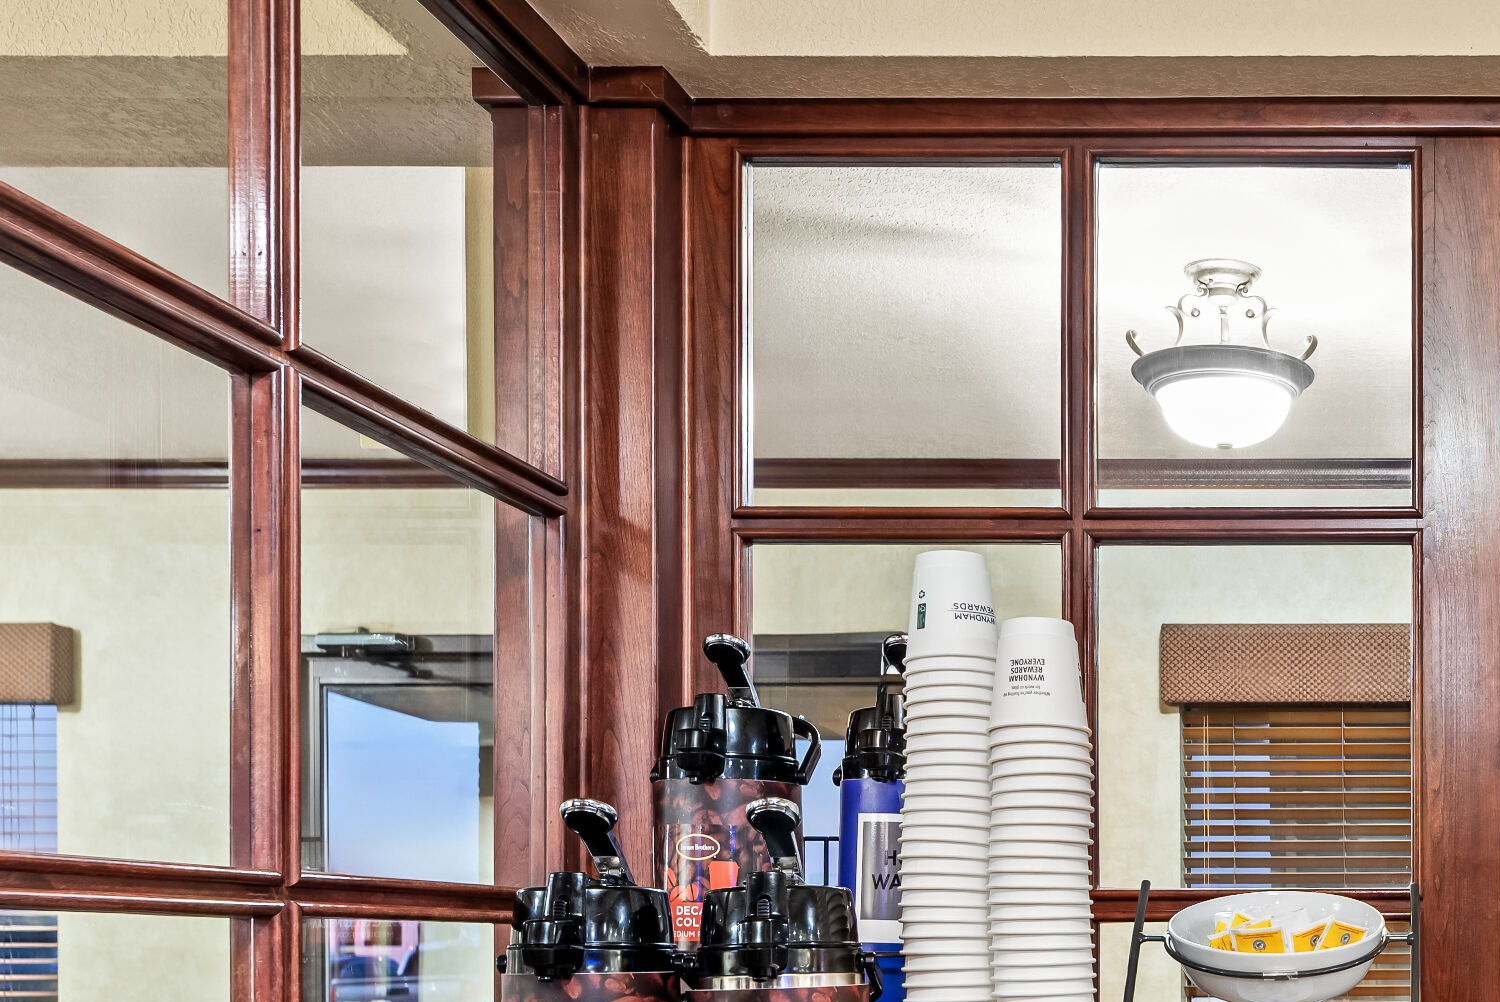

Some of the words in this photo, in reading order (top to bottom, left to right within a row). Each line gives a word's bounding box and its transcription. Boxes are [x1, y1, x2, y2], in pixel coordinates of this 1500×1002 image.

[952, 602, 994, 614] REWARDS
[954, 612, 995, 625] WYNDHAM
[1010, 666, 1043, 674] REWARDS
[1008, 674, 1045, 682] WYNDHAM
[885, 850, 902, 866] H
[676, 917, 701, 927] COL
